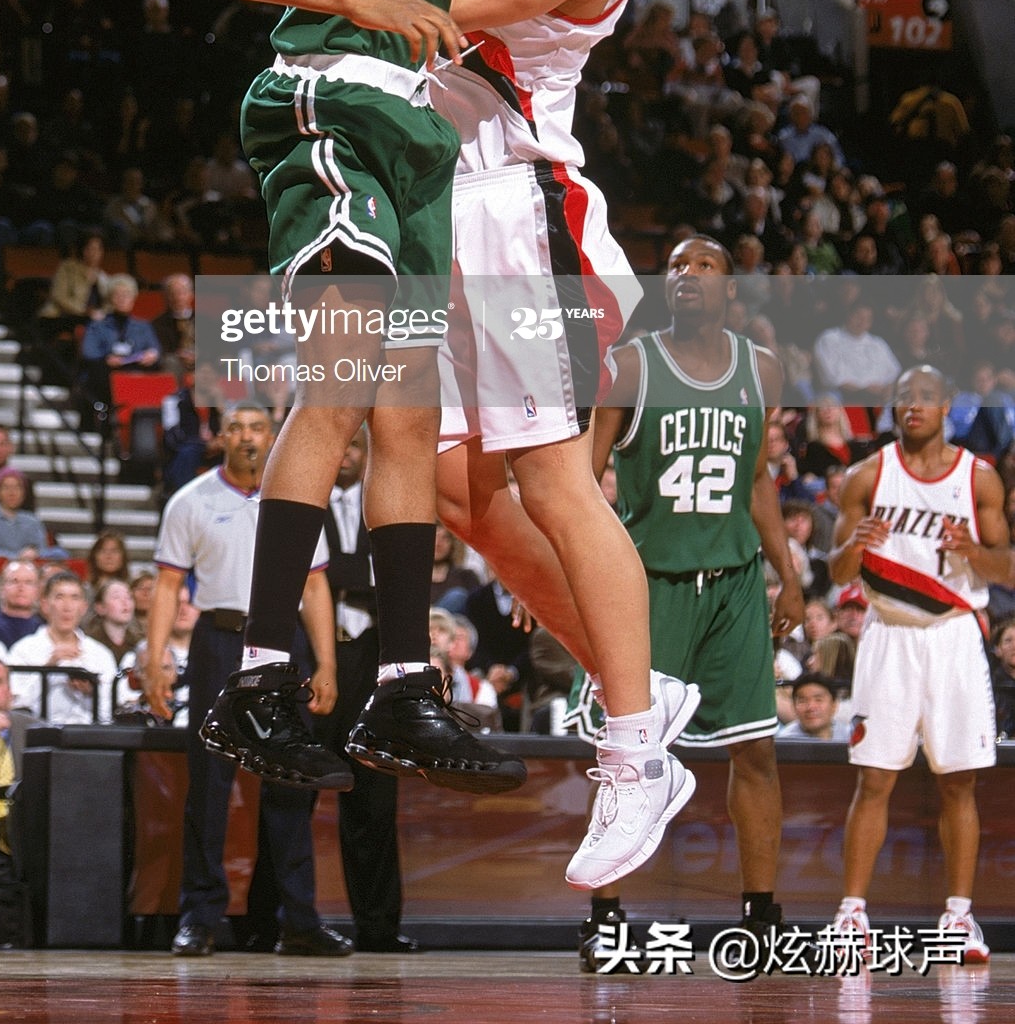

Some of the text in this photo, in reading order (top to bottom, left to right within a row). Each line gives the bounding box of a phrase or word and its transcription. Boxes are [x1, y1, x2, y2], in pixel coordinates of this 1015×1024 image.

[889, 14, 944, 48] 102
[660, 407, 747, 457] CELTICS
[657, 455, 737, 514] 42
